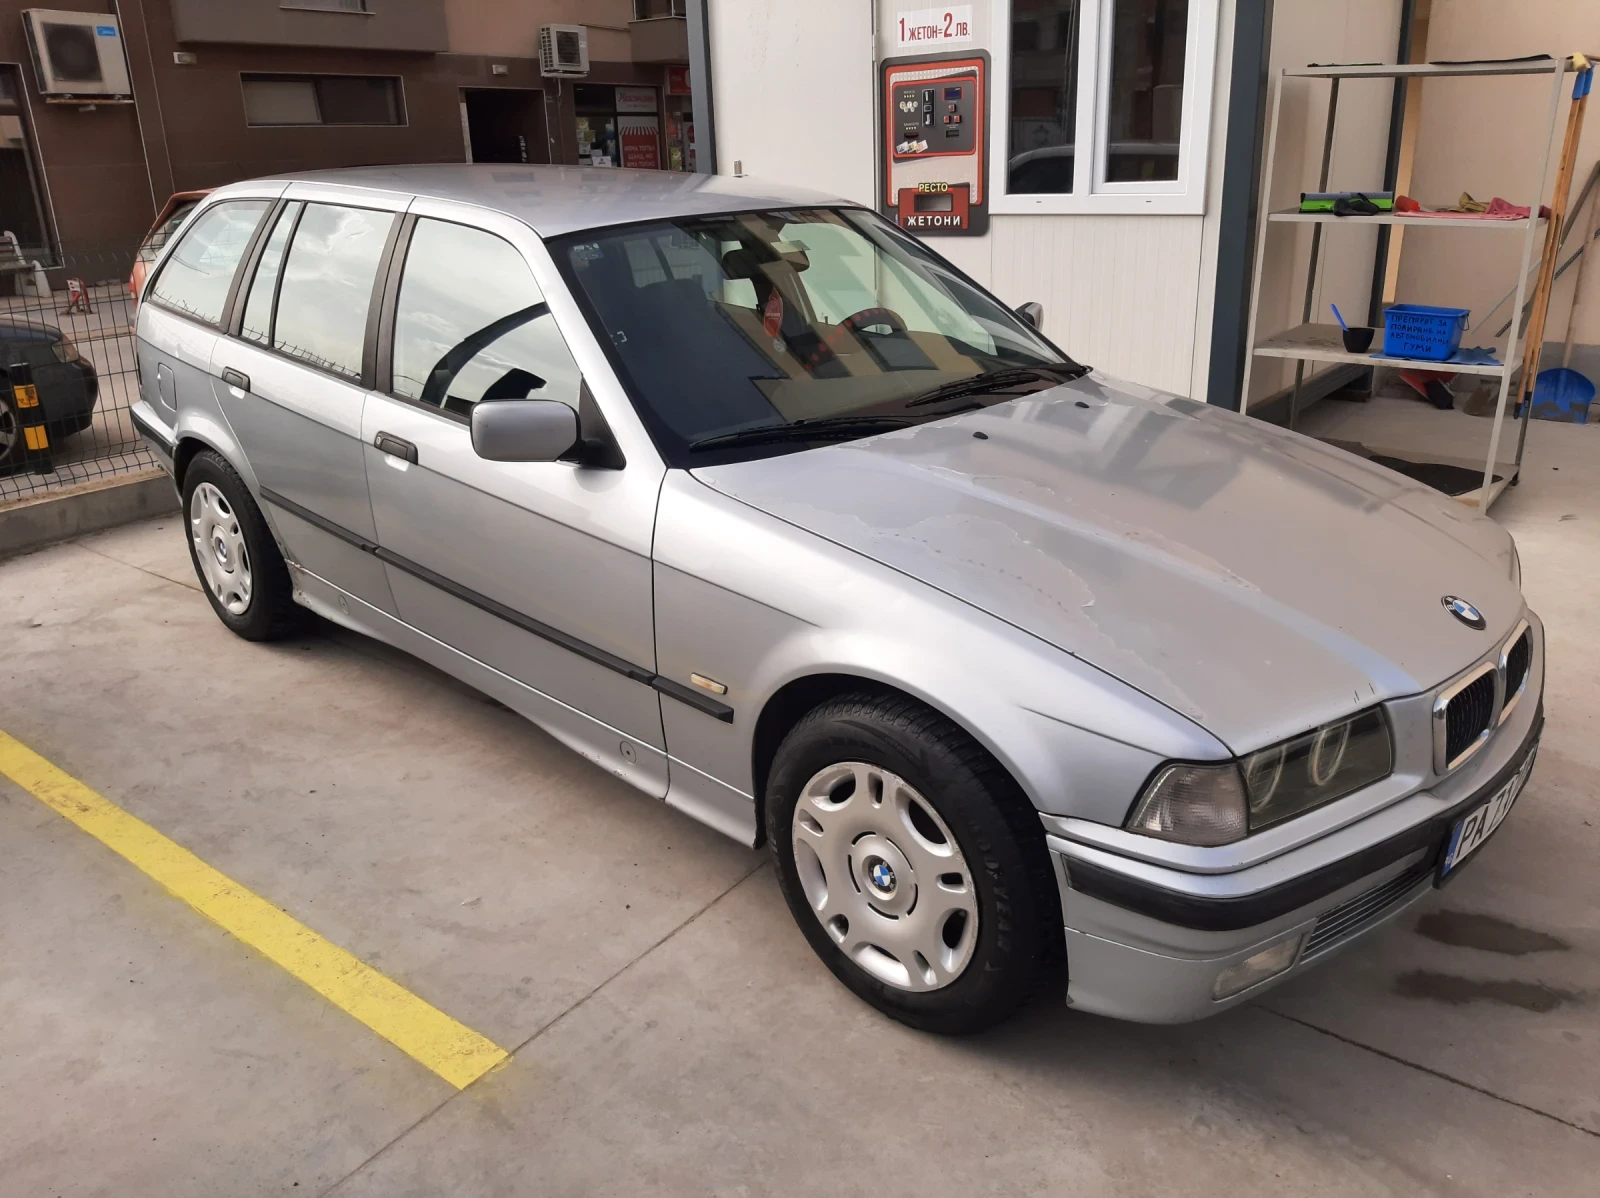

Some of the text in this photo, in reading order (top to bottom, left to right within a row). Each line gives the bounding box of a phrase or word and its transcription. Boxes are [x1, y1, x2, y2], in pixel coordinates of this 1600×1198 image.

[899, 17, 905, 42] 1
[918, 183, 949, 193] РЕСТО
[907, 215, 961, 227] ЖЕТОНИ
[1437, 319, 1447, 327] ЗА
[1403, 342, 1432, 353] ГУМИ
[1456, 804, 1489, 859] PA
